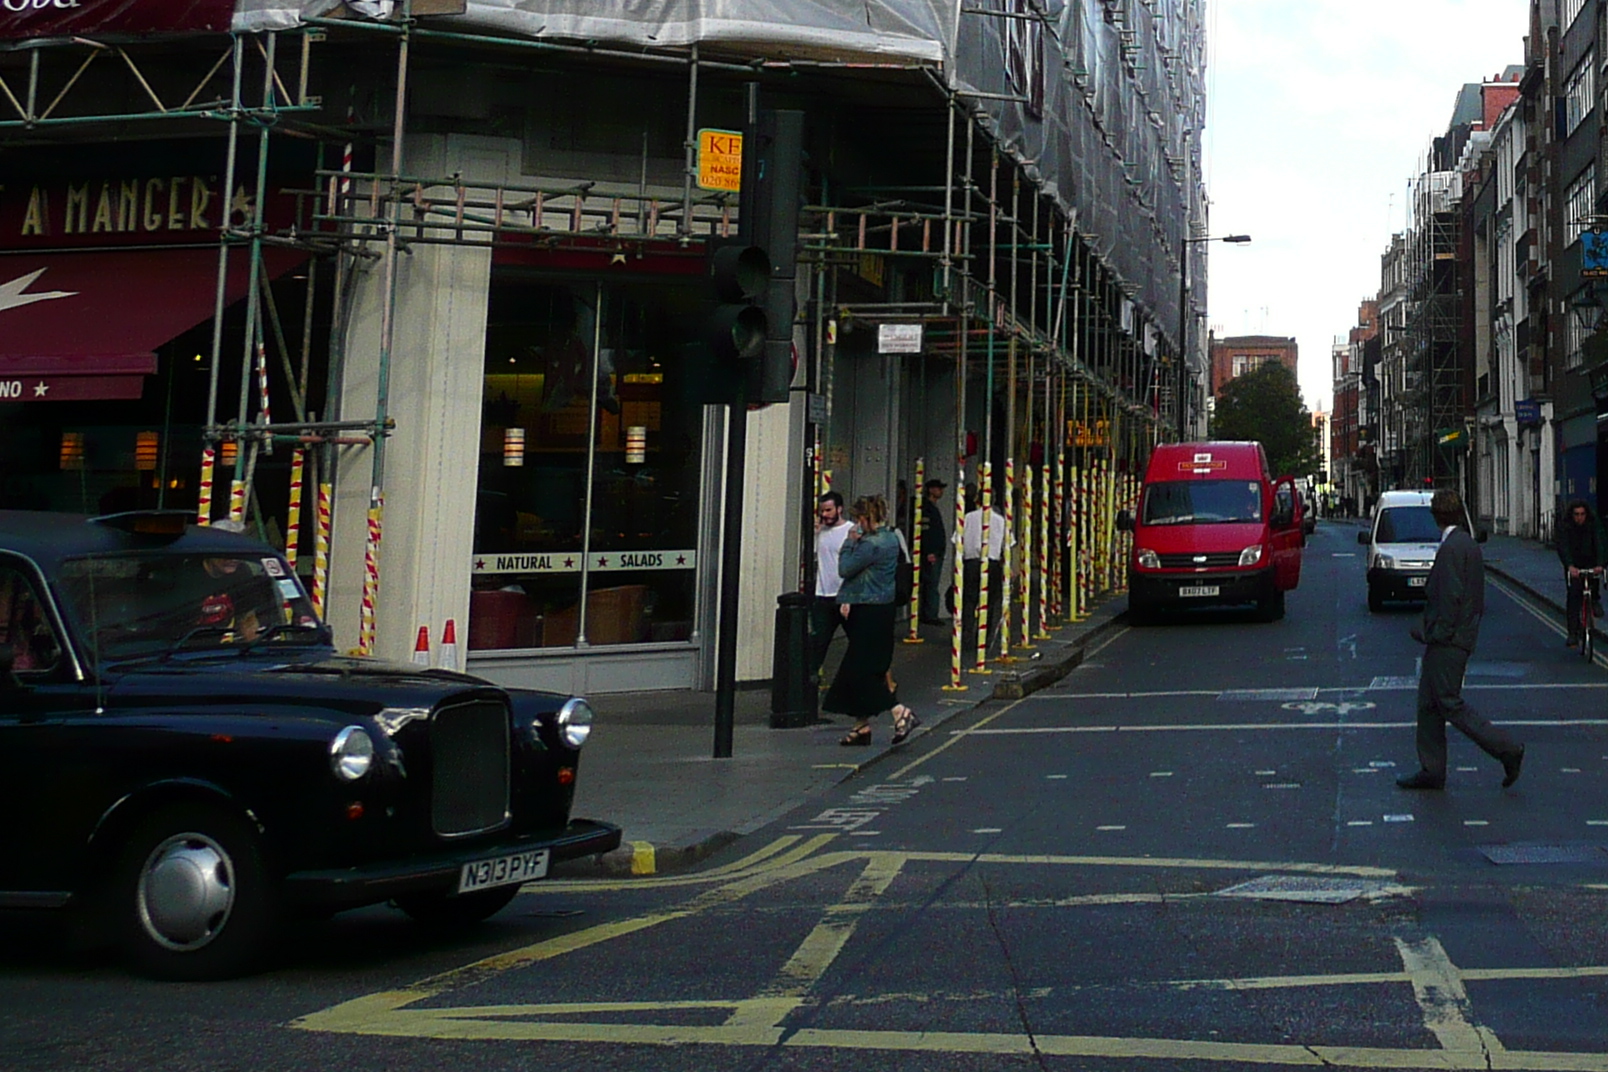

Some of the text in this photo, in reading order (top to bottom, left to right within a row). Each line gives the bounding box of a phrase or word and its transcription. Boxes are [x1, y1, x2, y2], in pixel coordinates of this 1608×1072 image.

[21, 178, 210, 235] A MANGER
[496, 556, 552, 570] NATURAL
[620, 553, 663, 568] SALADS
